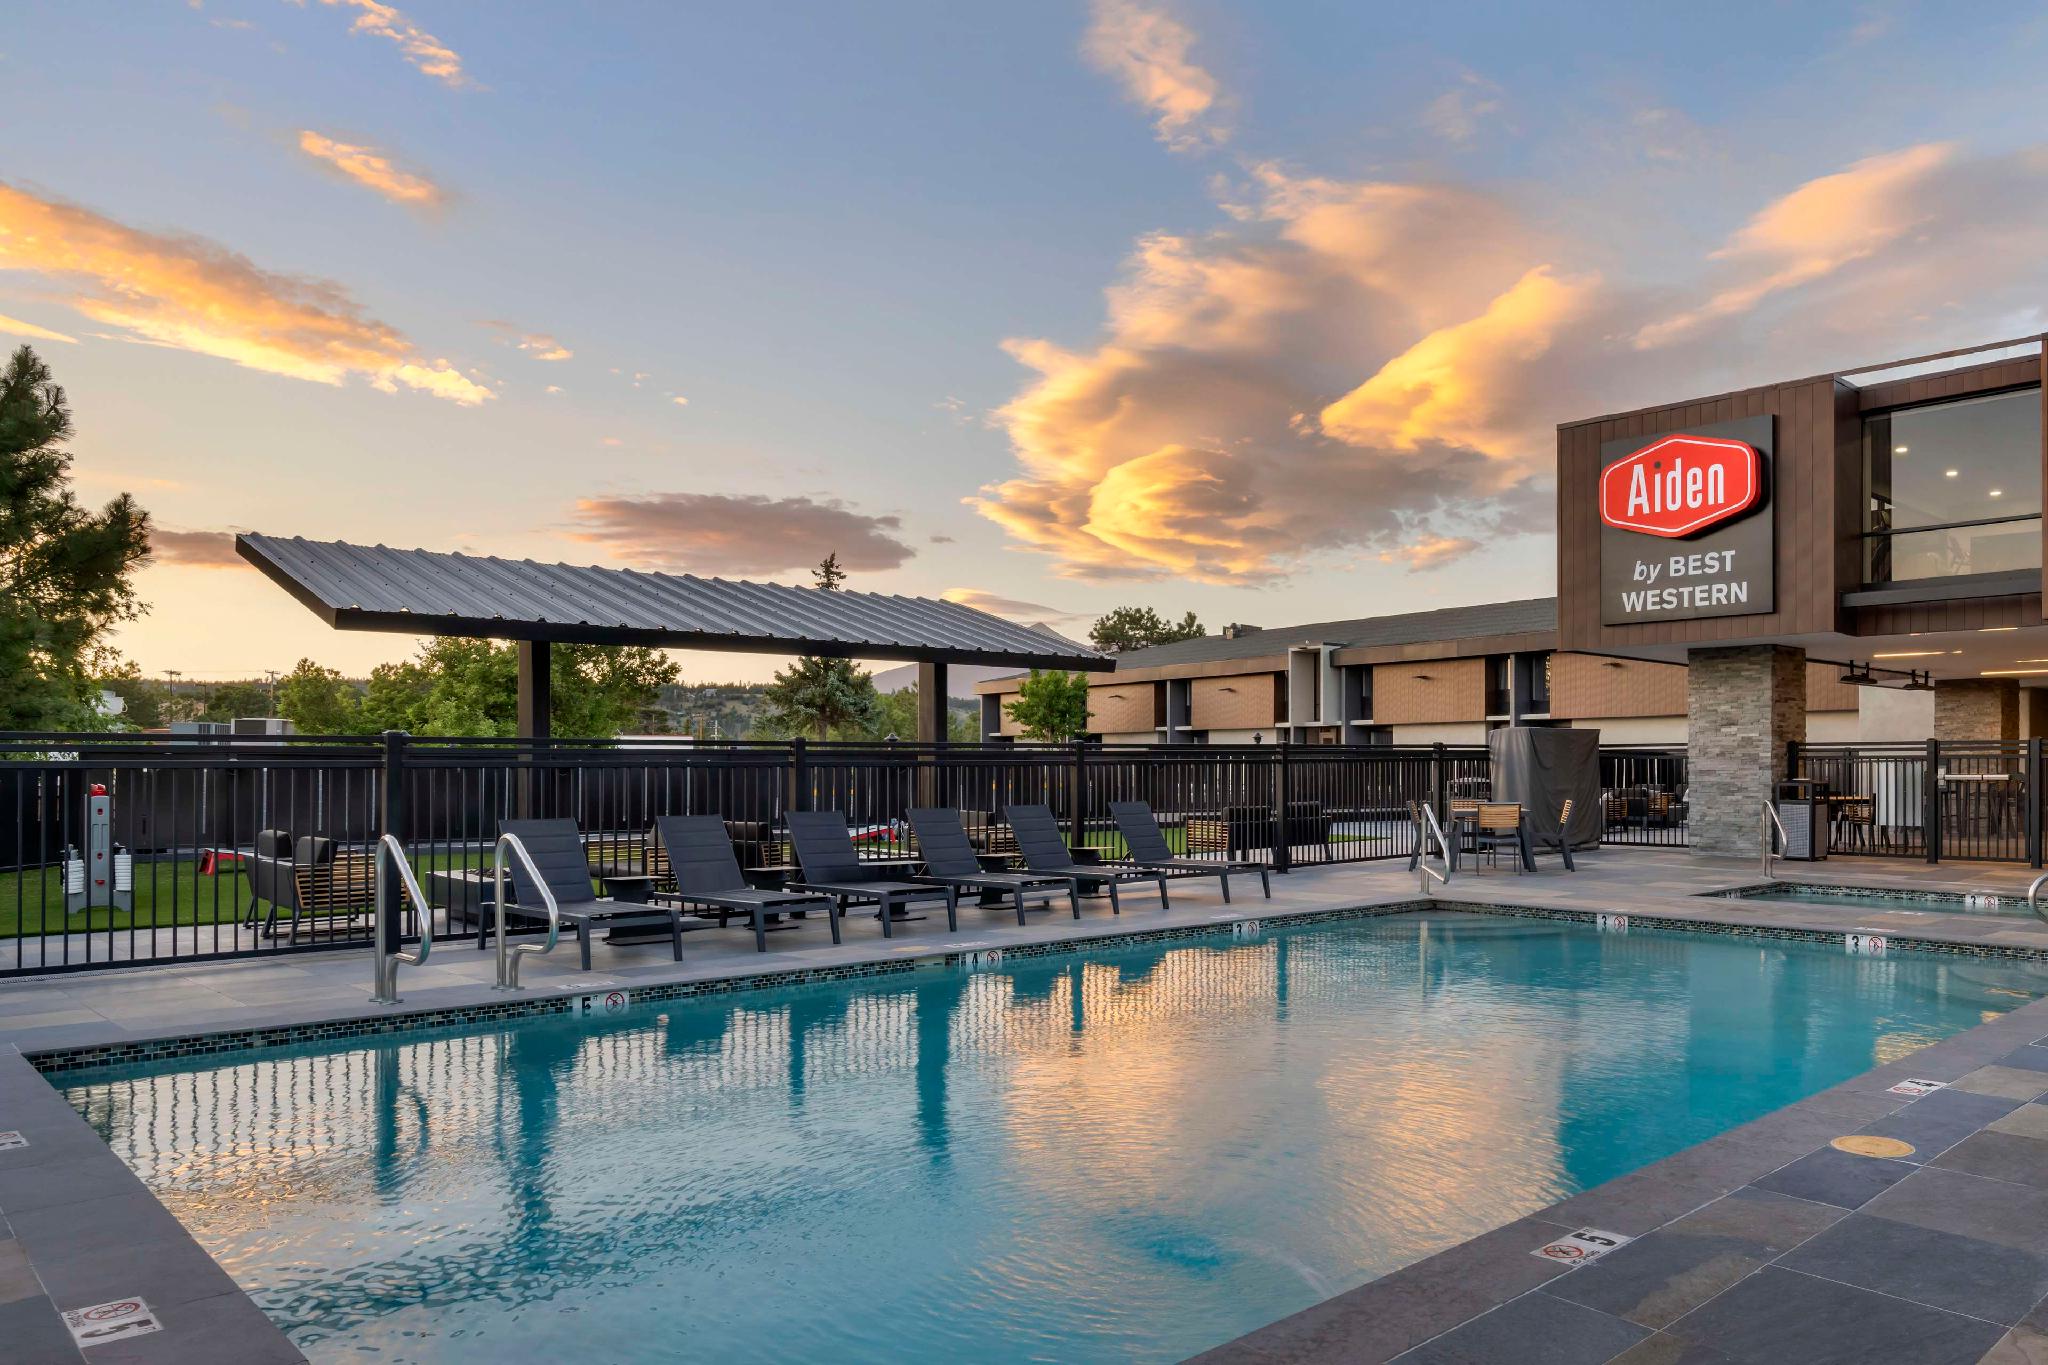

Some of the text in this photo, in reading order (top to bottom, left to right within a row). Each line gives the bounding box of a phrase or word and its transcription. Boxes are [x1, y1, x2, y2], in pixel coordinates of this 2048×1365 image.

[1627, 457, 1725, 517] Aiden
[1633, 550, 1736, 584] by BEST
[1622, 581, 1748, 613] WESTERN
[1571, 1232, 1617, 1247] 5
[80, 1318, 154, 1339] 5
